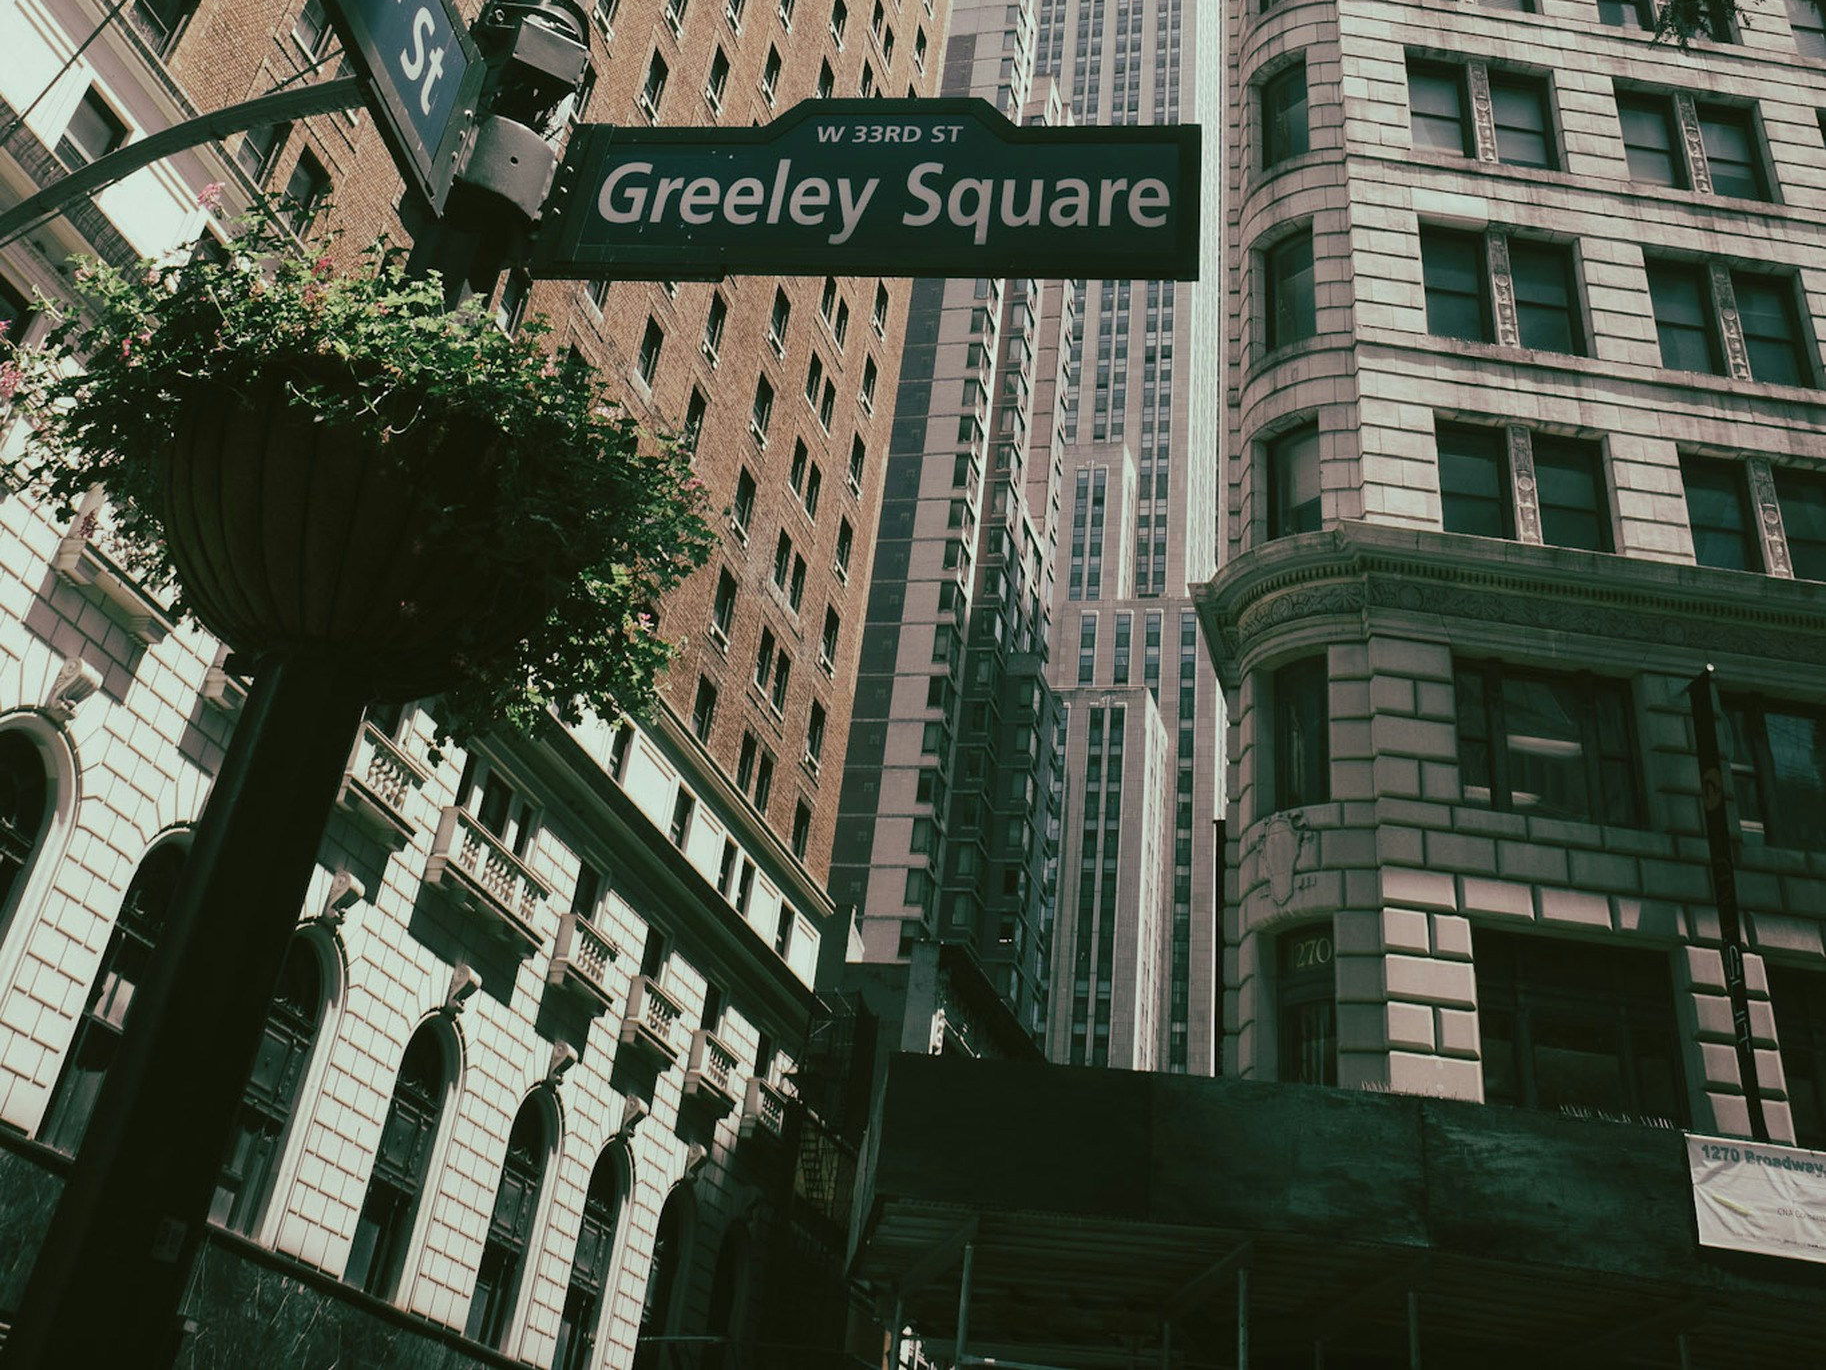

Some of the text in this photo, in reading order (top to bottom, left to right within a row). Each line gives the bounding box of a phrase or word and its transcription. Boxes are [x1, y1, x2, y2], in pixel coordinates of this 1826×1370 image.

[400, 6, 445, 117] St
[817, 125, 964, 144] W 33RD ST
[597, 158, 1171, 246] Greeley Square
[1701, 1144, 1740, 1163] 1270
